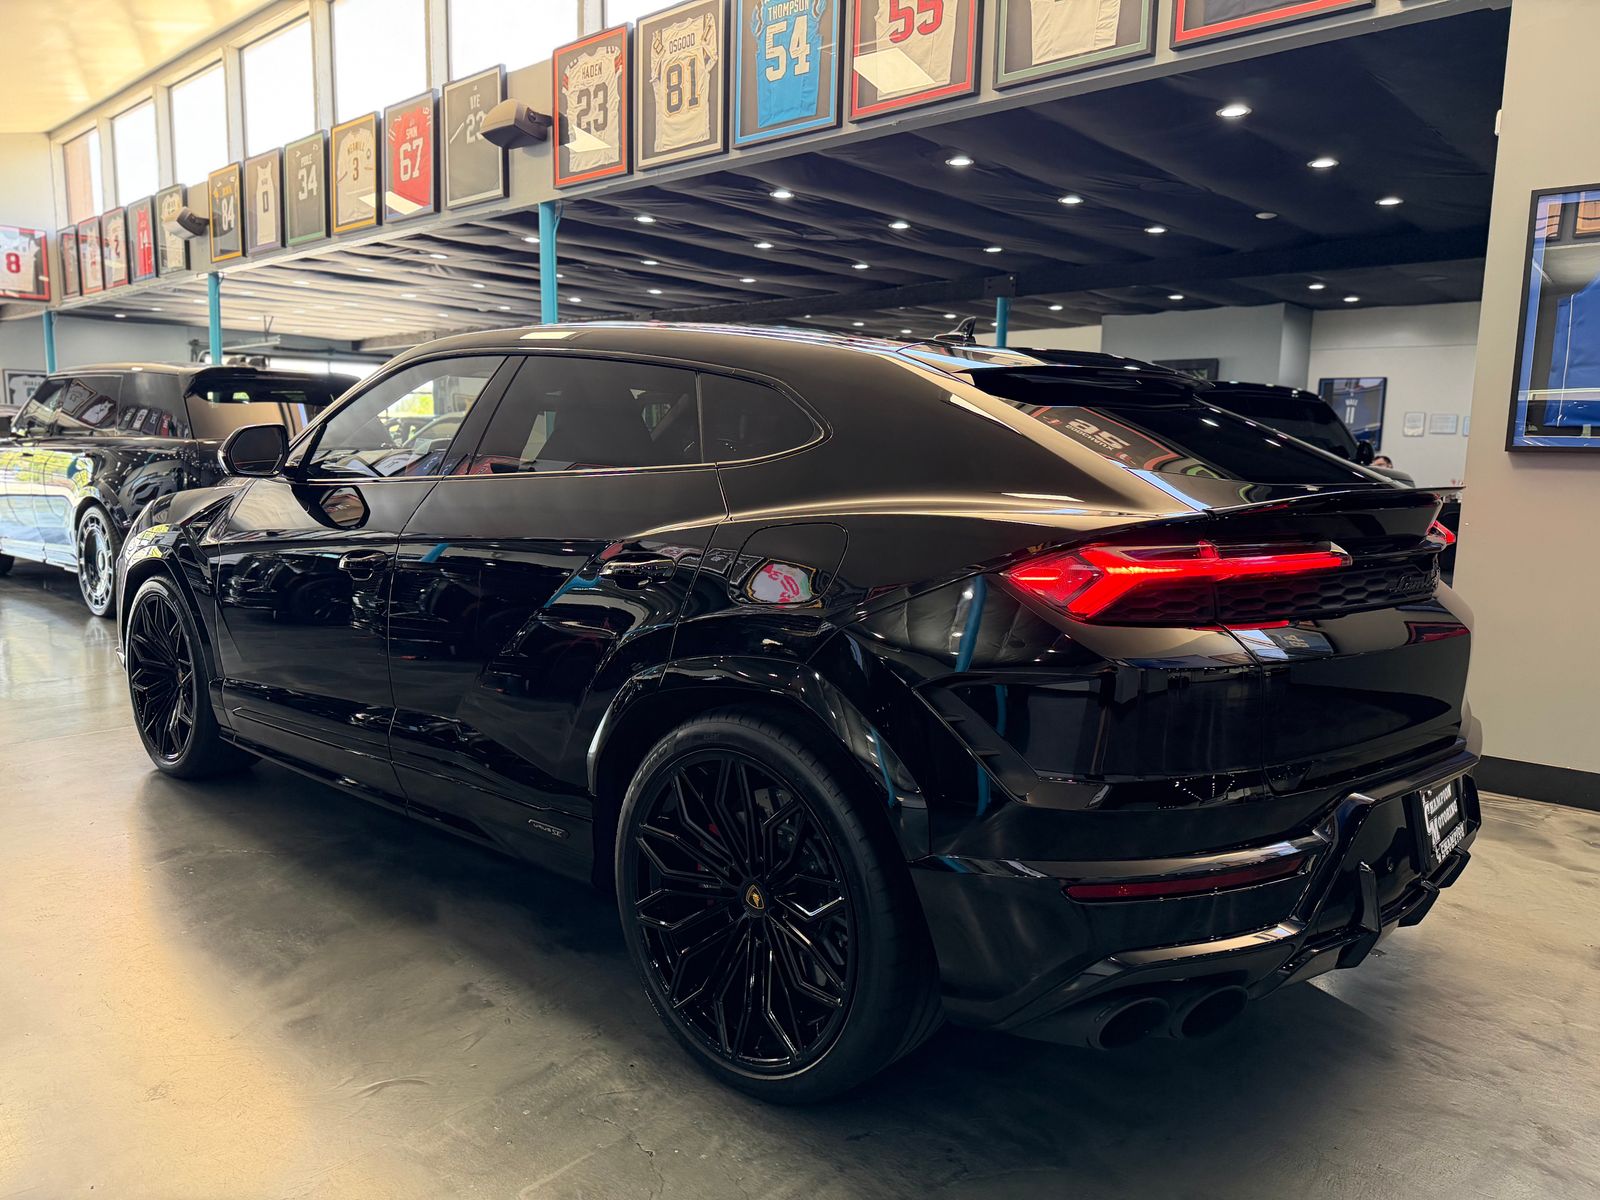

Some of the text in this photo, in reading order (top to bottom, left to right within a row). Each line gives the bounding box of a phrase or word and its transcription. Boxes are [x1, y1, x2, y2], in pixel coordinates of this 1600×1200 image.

[768, 0, 809, 21] THOMPSON
[765, 14, 810, 82] 54
[581, 61, 603, 79] HADEN
[665, 56, 700, 114] 81
[576, 82, 609, 134] 23
[353, 157, 360, 181] 3
[400, 137, 424, 182] 67
[298, 164, 318, 201] 34
[221, 195, 235, 231] 84
[5, 252, 21, 274] 8
[1344, 406, 1355, 424] 11
